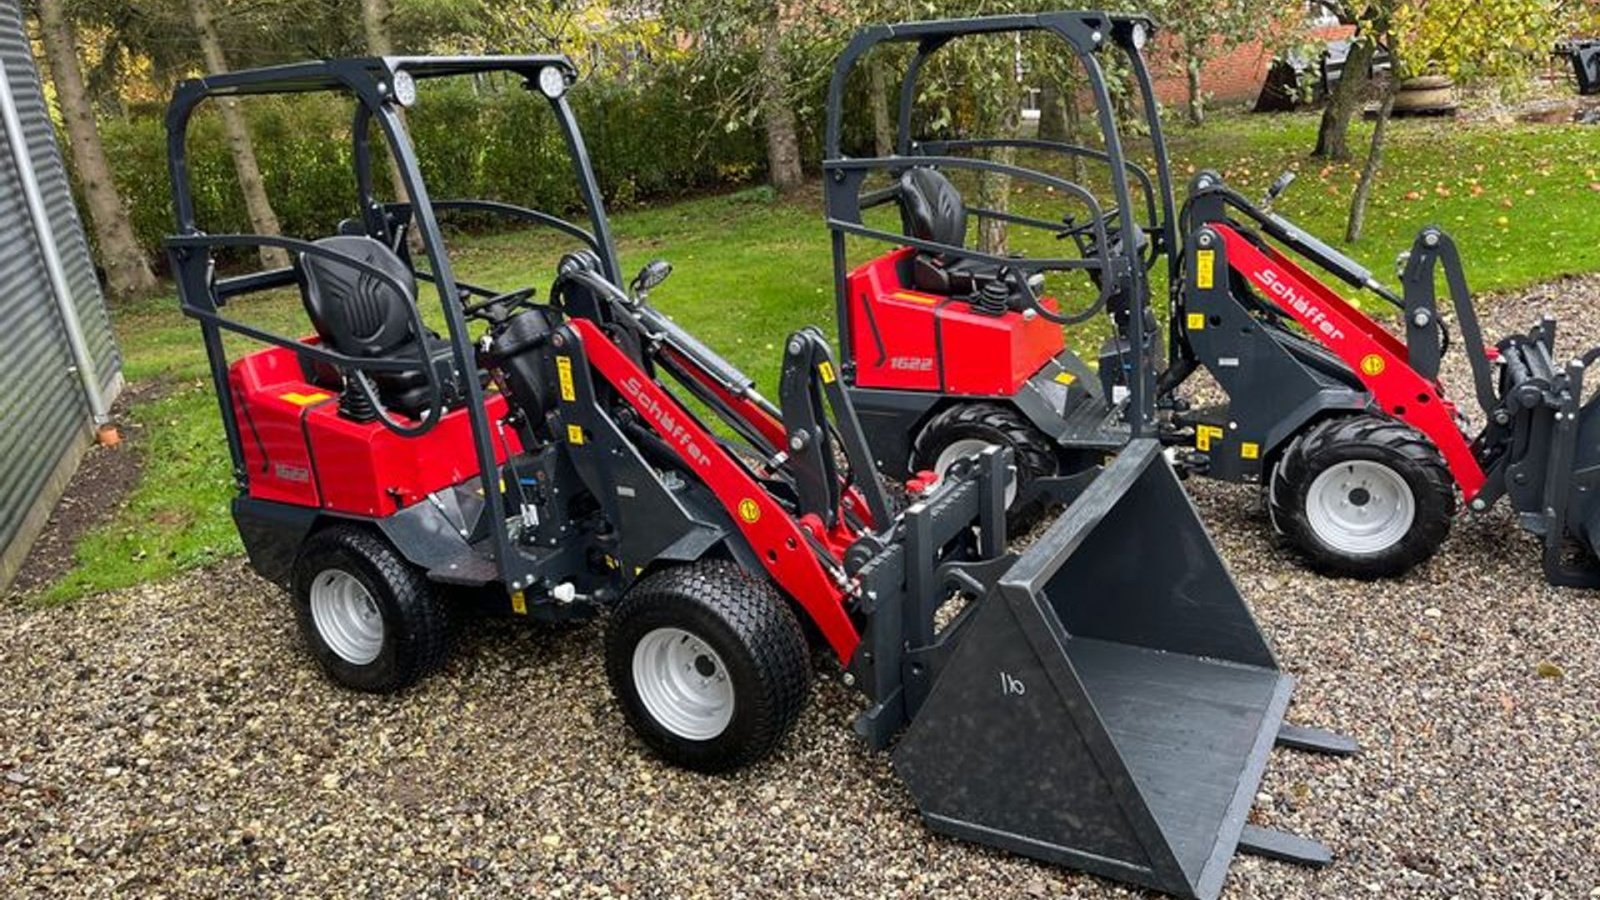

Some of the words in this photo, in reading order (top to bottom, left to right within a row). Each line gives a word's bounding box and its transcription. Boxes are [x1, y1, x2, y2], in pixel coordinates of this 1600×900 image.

[1253, 269, 1345, 340] Schäffer
[891, 357, 933, 371] 1622
[620, 377, 711, 467] Schäffer
